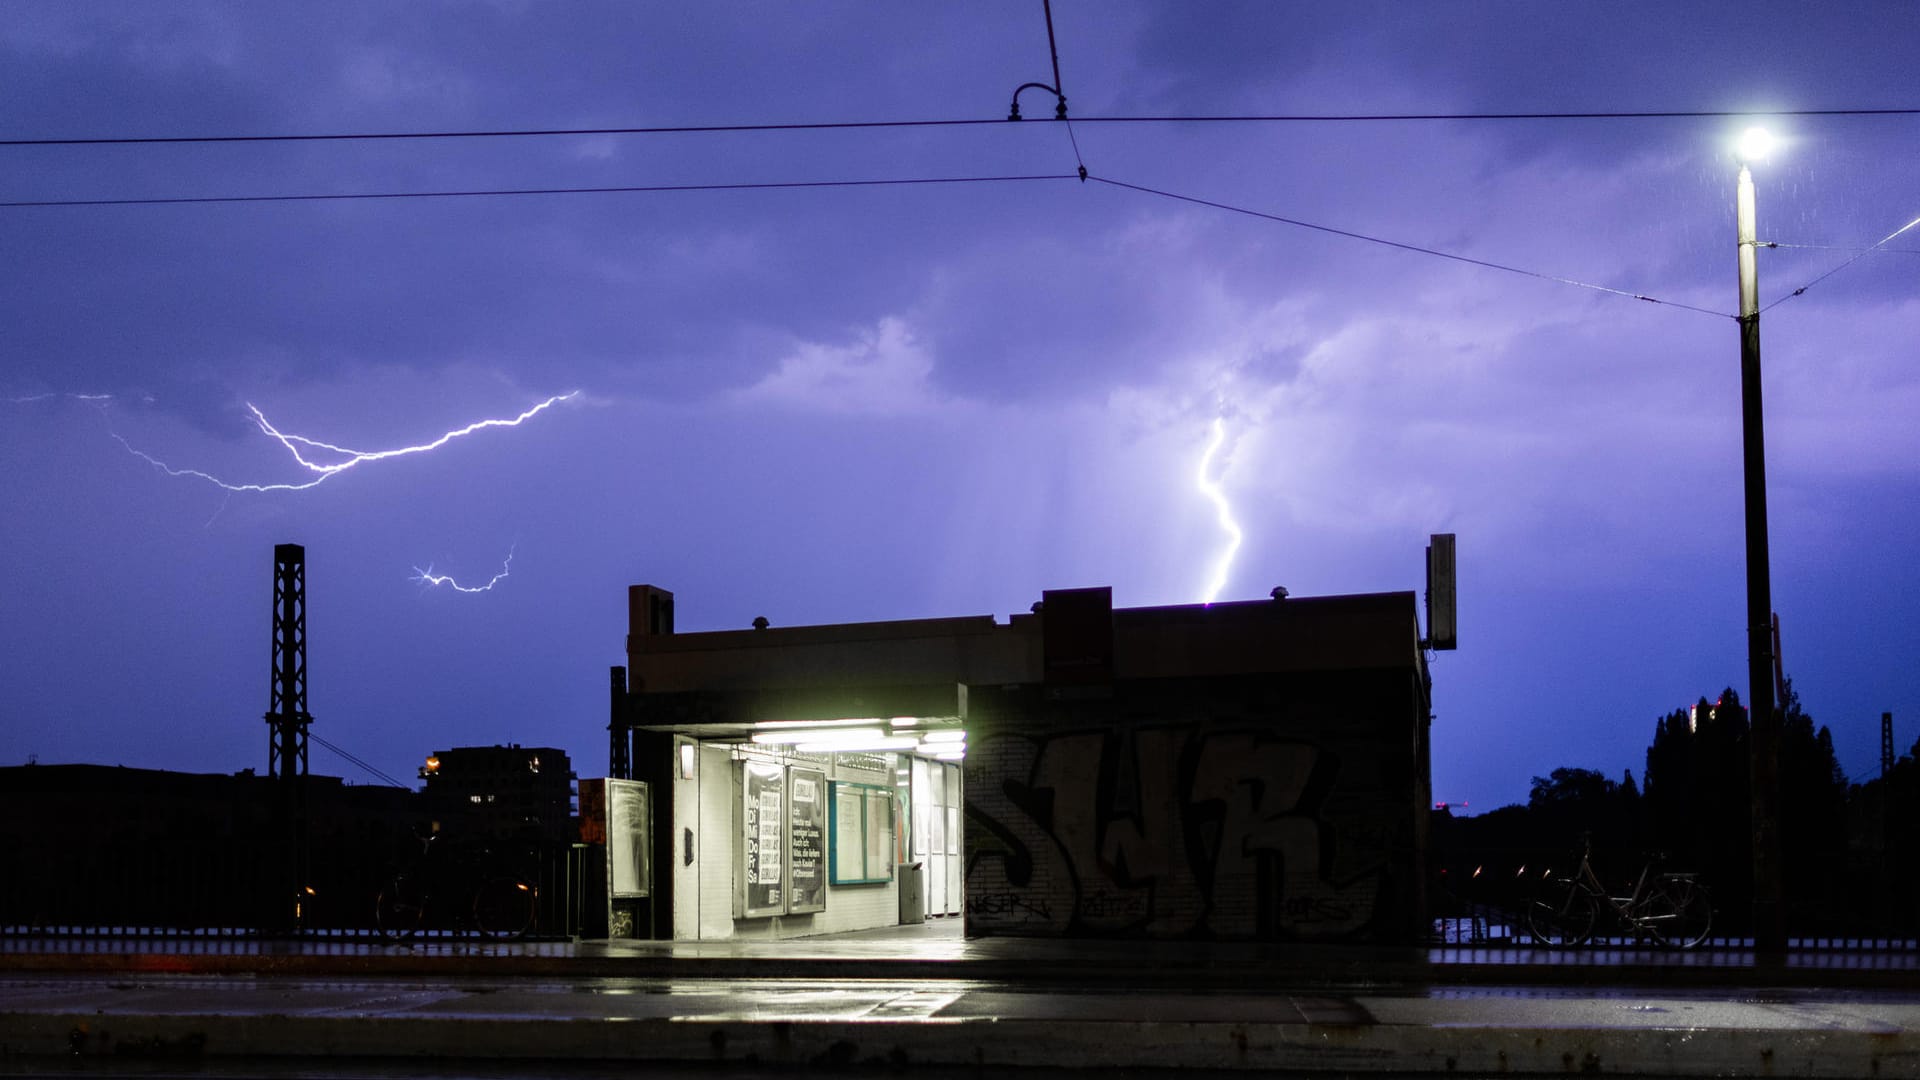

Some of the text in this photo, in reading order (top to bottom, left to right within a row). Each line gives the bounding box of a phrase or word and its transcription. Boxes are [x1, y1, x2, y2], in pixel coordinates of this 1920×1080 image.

[748, 795, 760, 809] Mo
[748, 810, 757, 823] Di
[748, 840, 759, 854] Do
[748, 855, 757, 867] Fr
[748, 870, 758, 883] Sa
